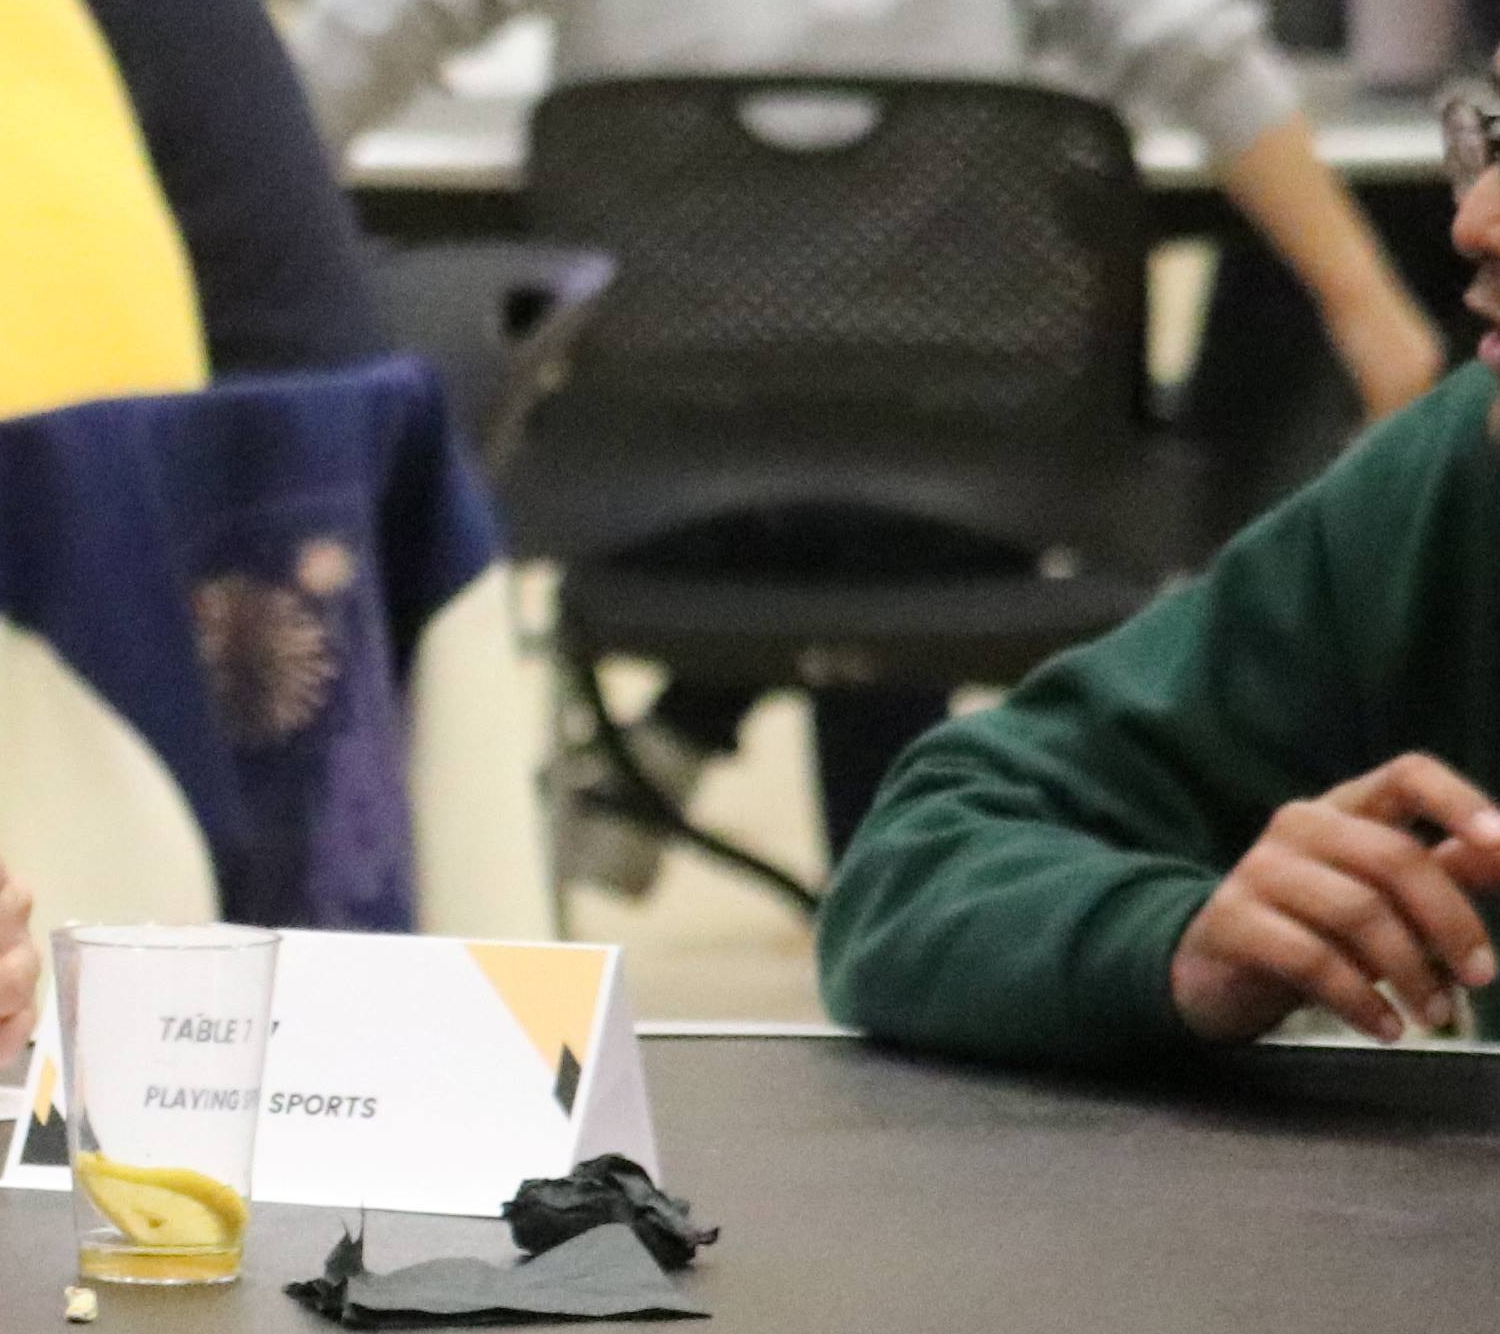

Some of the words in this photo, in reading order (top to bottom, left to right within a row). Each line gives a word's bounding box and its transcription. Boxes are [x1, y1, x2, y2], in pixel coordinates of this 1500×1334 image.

[160, 1017, 236, 1045] TABLE
[143, 1085, 242, 1112] PLAYING
[268, 1092, 378, 1119] SPORTS
